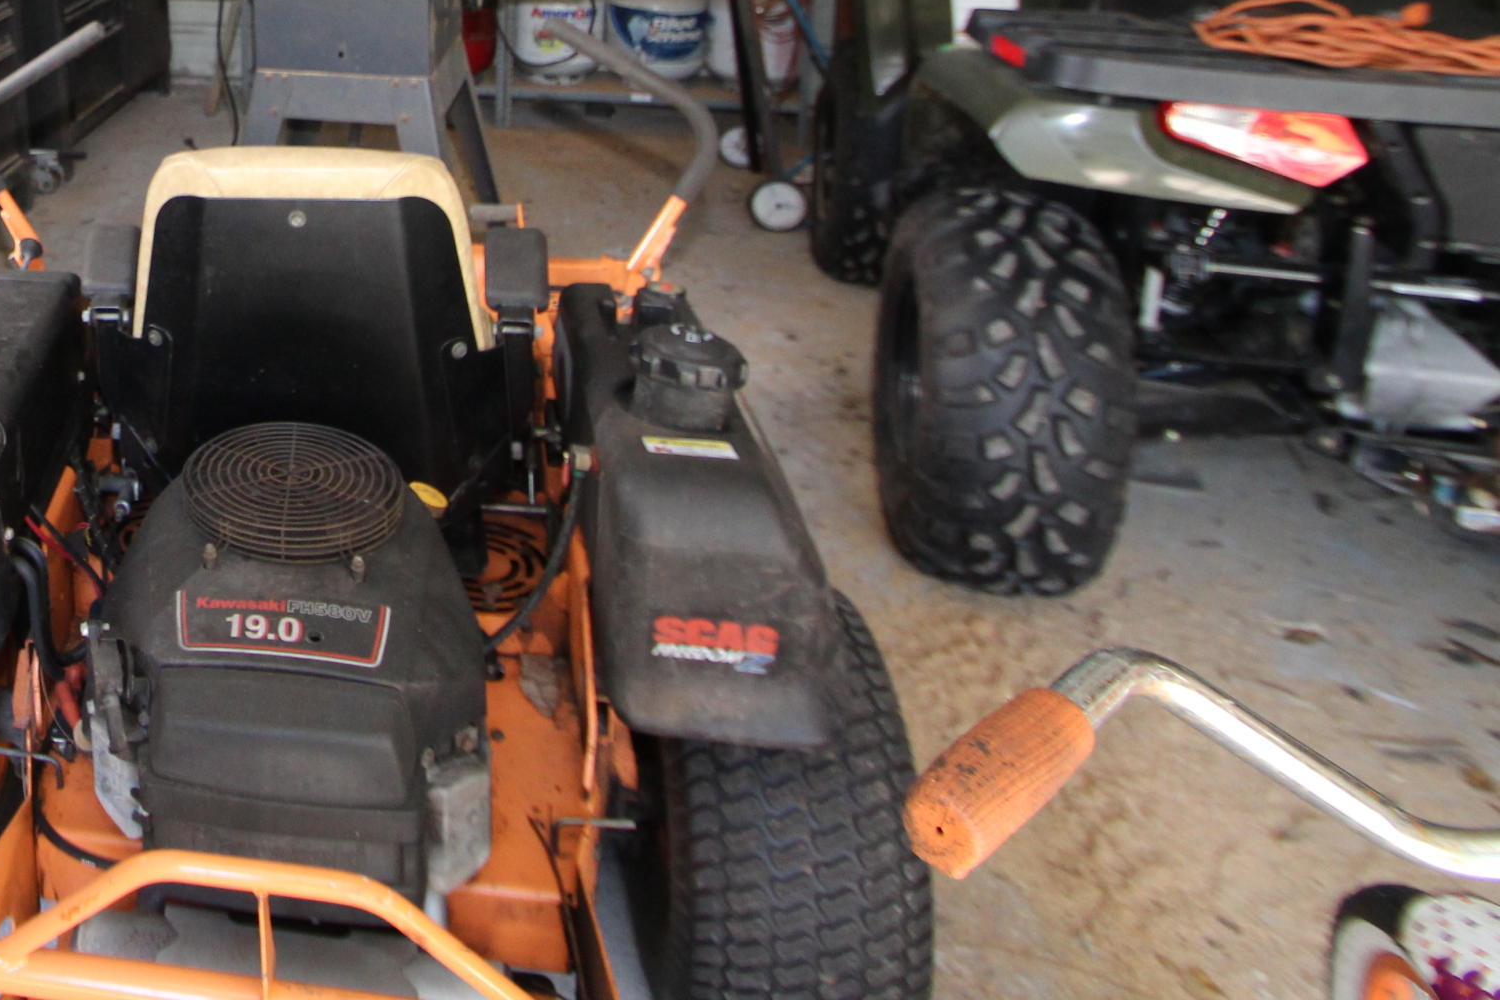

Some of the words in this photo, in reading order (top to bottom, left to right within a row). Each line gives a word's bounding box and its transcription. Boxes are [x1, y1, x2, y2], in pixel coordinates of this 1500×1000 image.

[196, 596, 287, 612] Kawasaki
[225, 613, 305, 643] 19.0
[652, 615, 780, 655] SCAG
